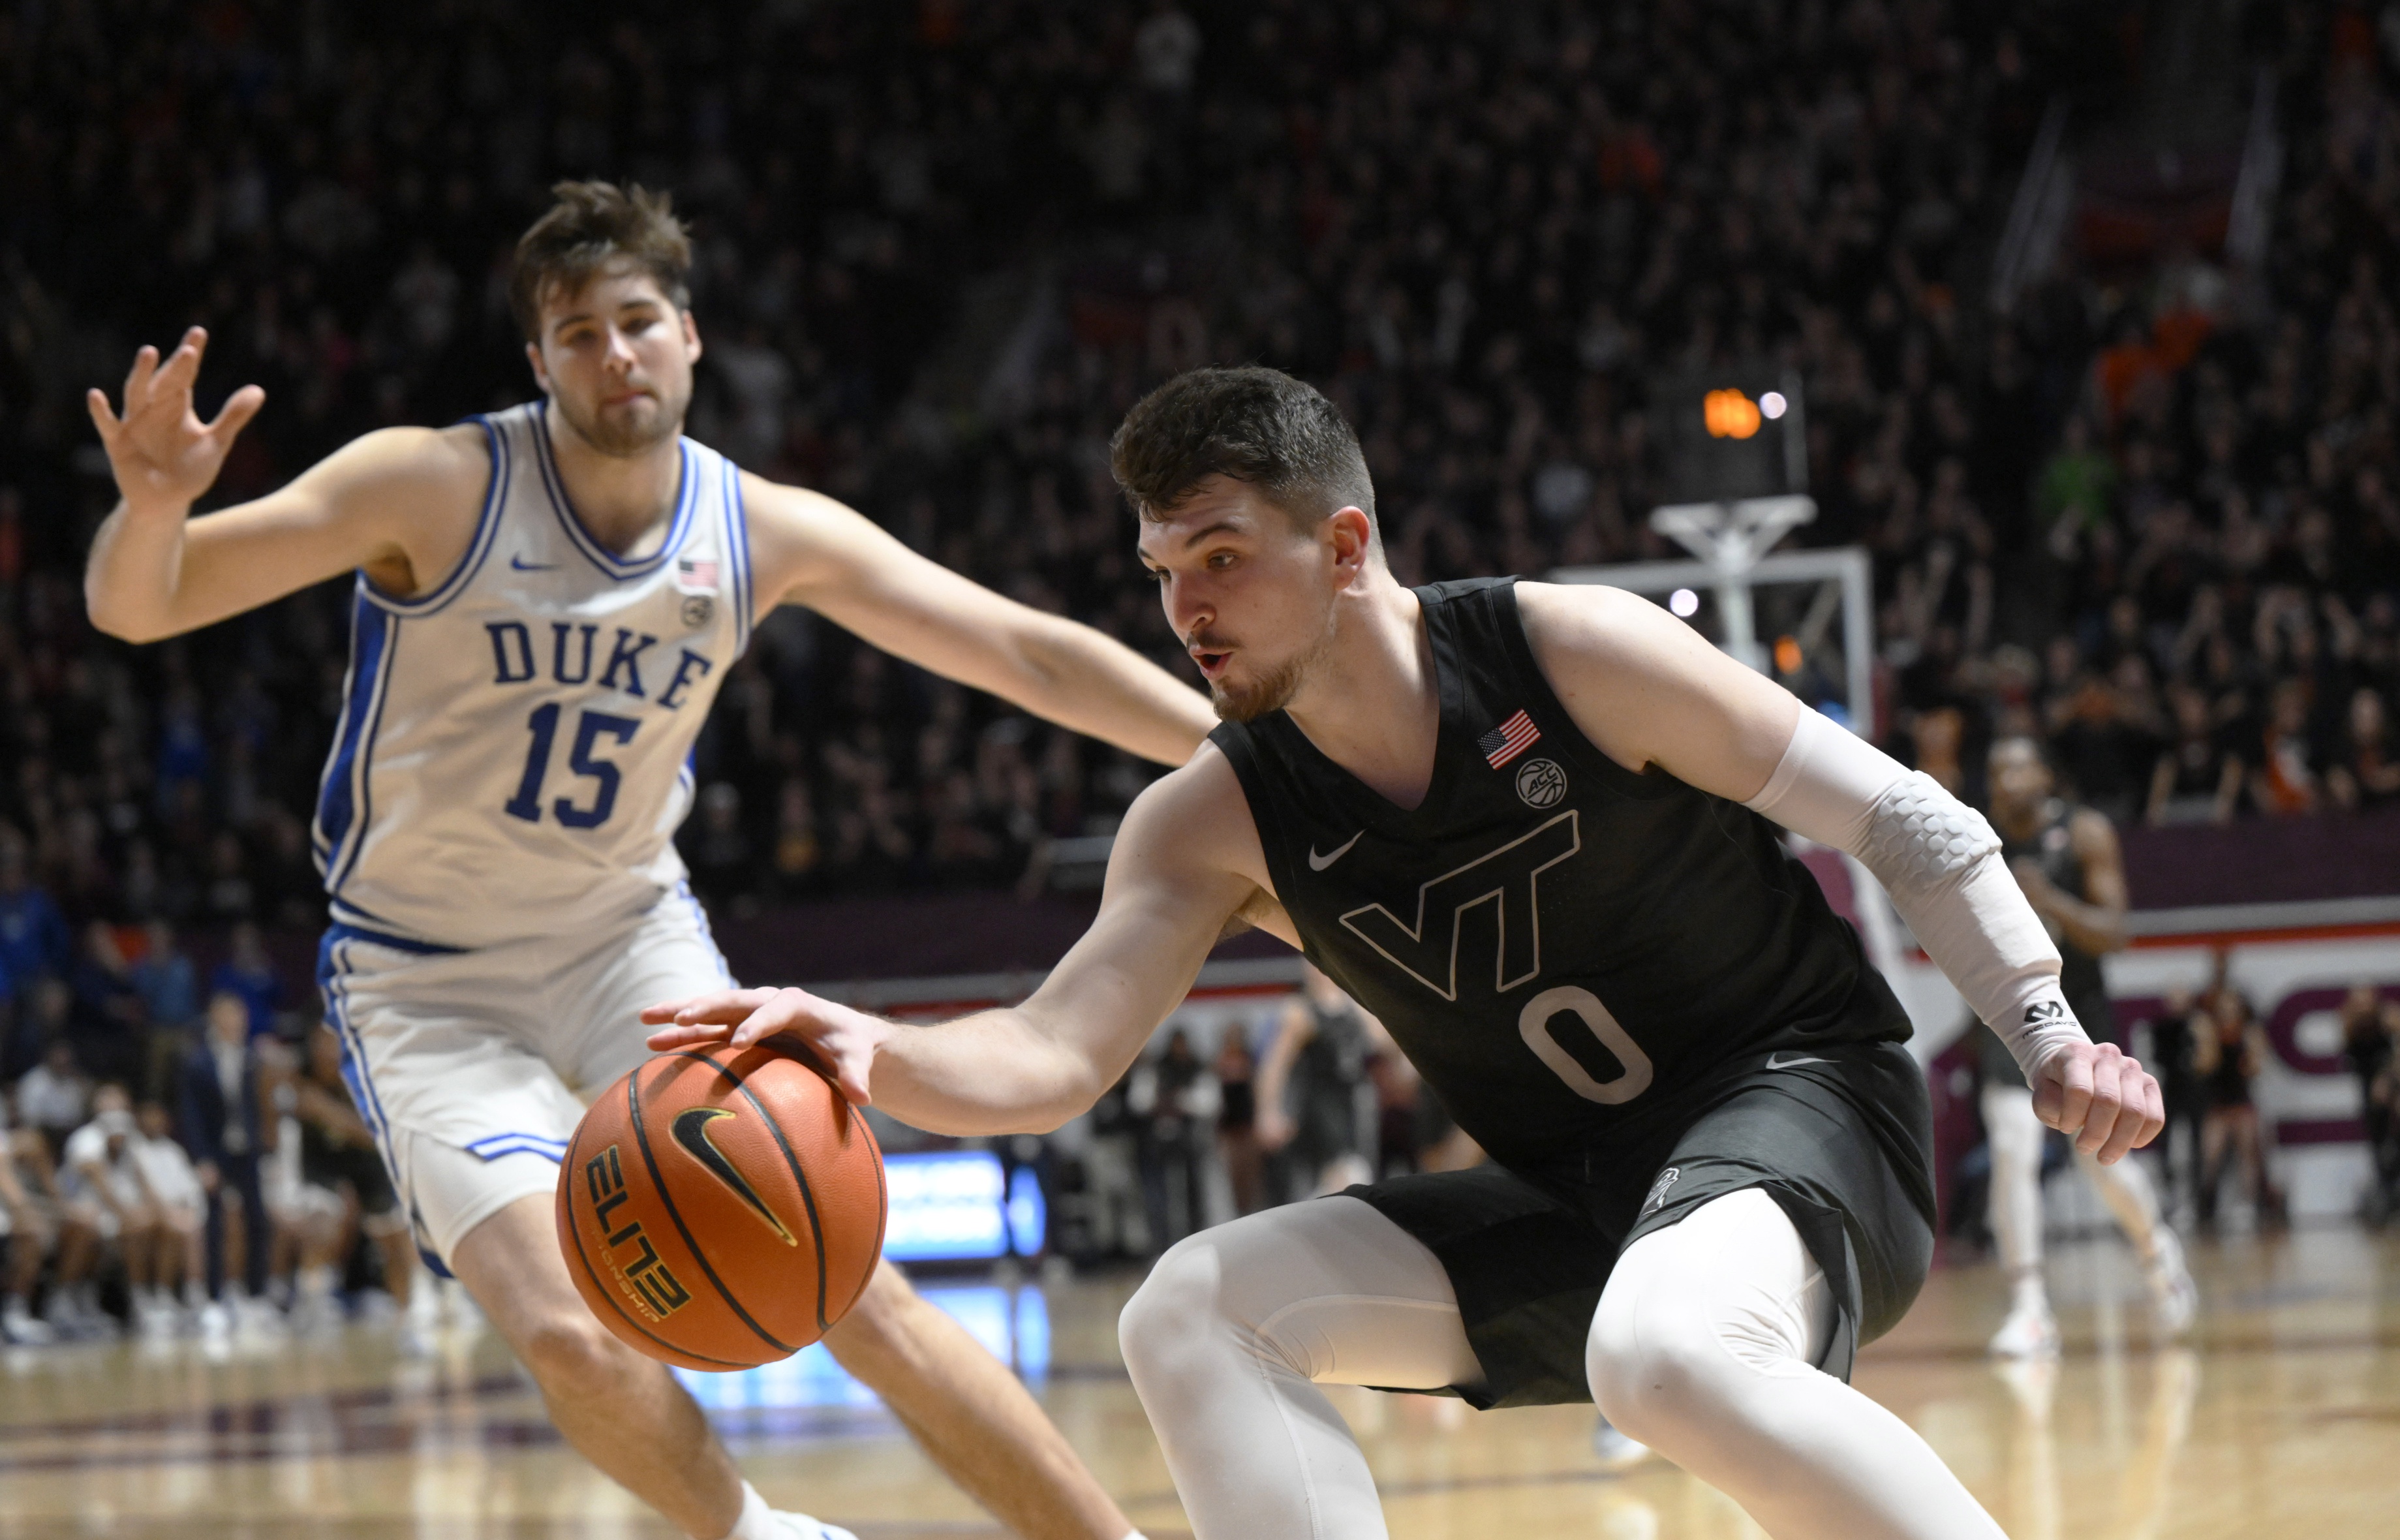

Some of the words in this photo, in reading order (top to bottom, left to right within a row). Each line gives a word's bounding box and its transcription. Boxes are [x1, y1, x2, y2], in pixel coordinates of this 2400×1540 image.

[484, 621, 713, 710] DUKE
[504, 701, 642, 828] 15
[1528, 764, 1558, 795] ACC
[1339, 809, 1580, 1002] VT
[1518, 985, 1654, 1104] 0
[586, 1144, 692, 1319] ELITE
